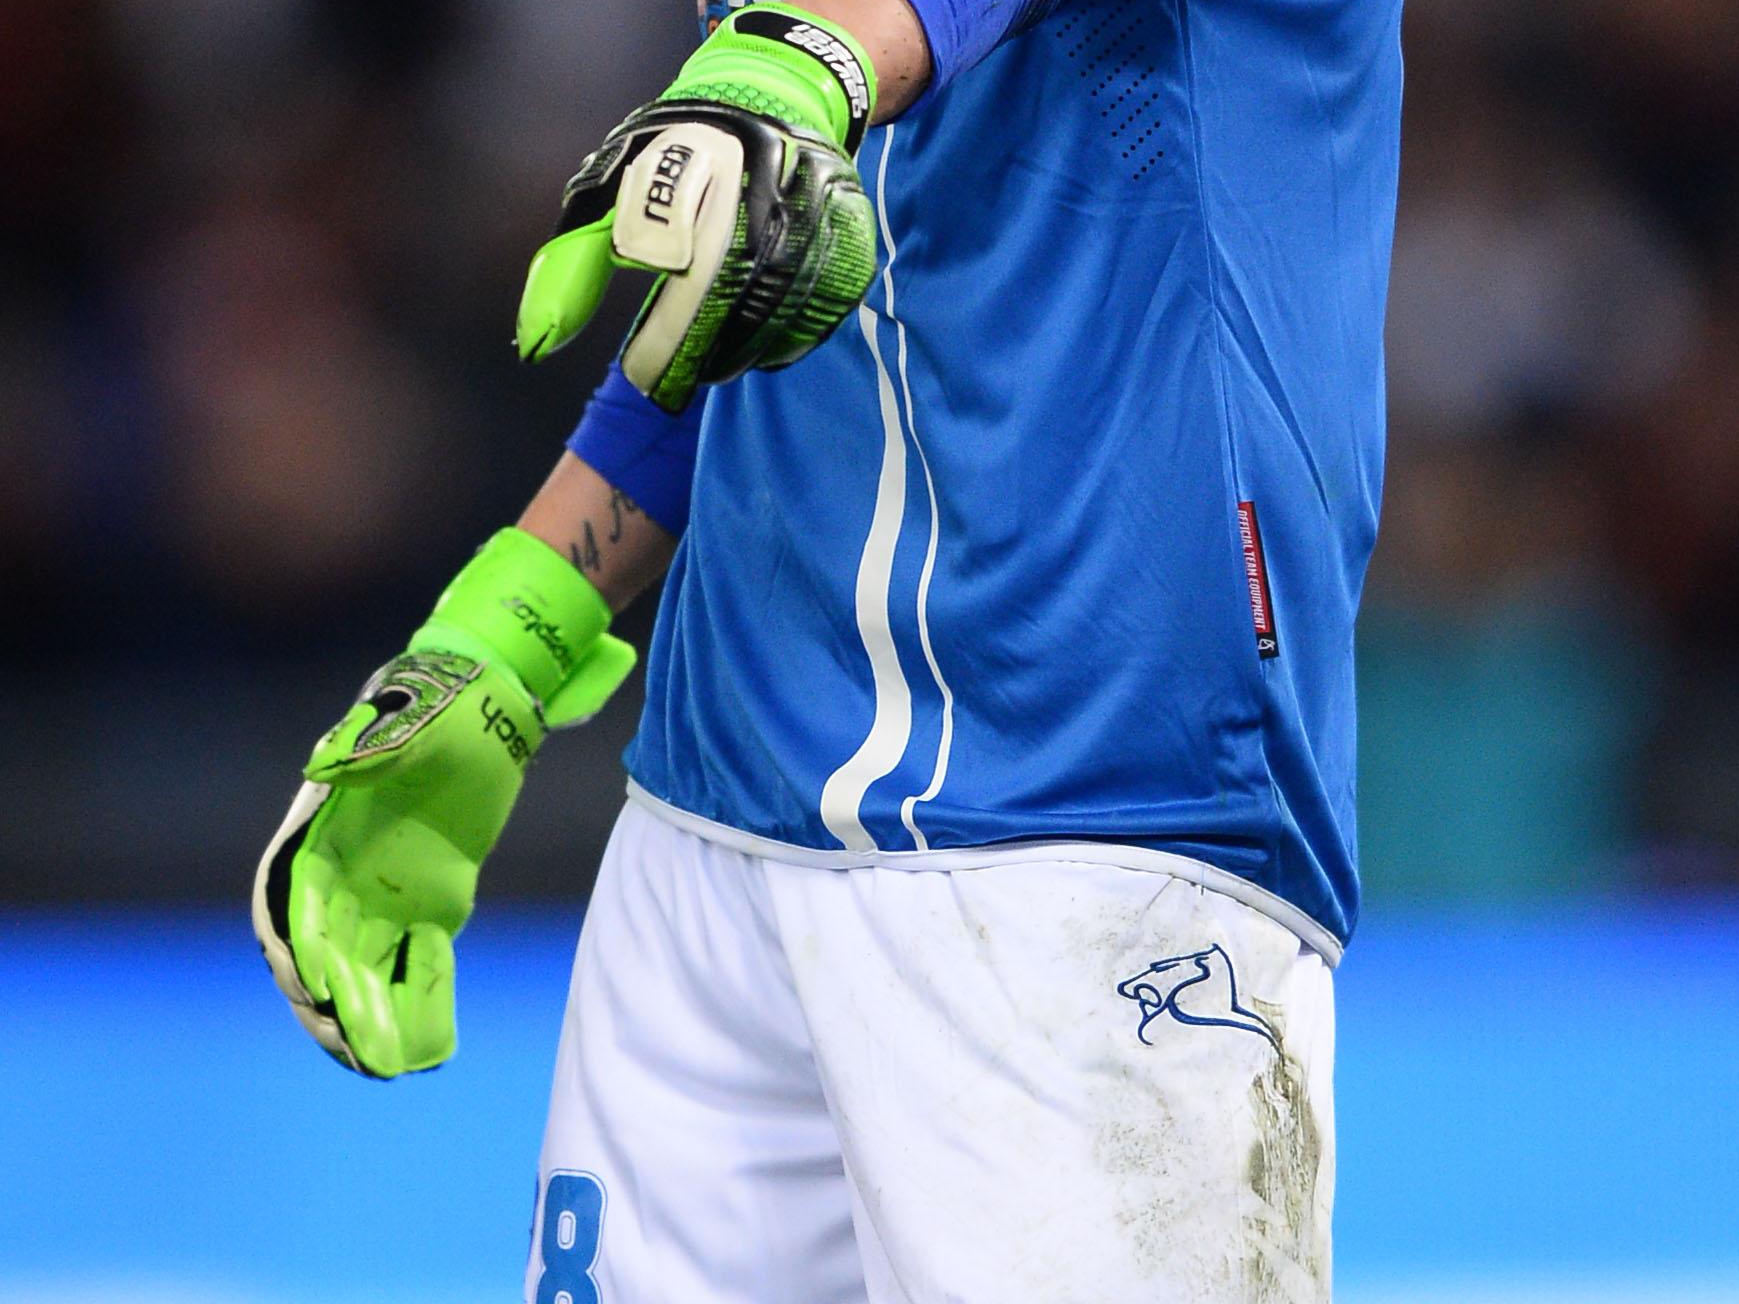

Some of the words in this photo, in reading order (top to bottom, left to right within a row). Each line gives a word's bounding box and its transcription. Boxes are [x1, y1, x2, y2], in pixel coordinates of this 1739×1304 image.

[1237, 509, 1253, 549] OFFICIAL
[1243, 551, 1257, 576] TEAM
[1248, 578, 1266, 630] EQUIPMENT
[480, 694, 531, 766] sch
[530, 1168, 607, 1304] 8
